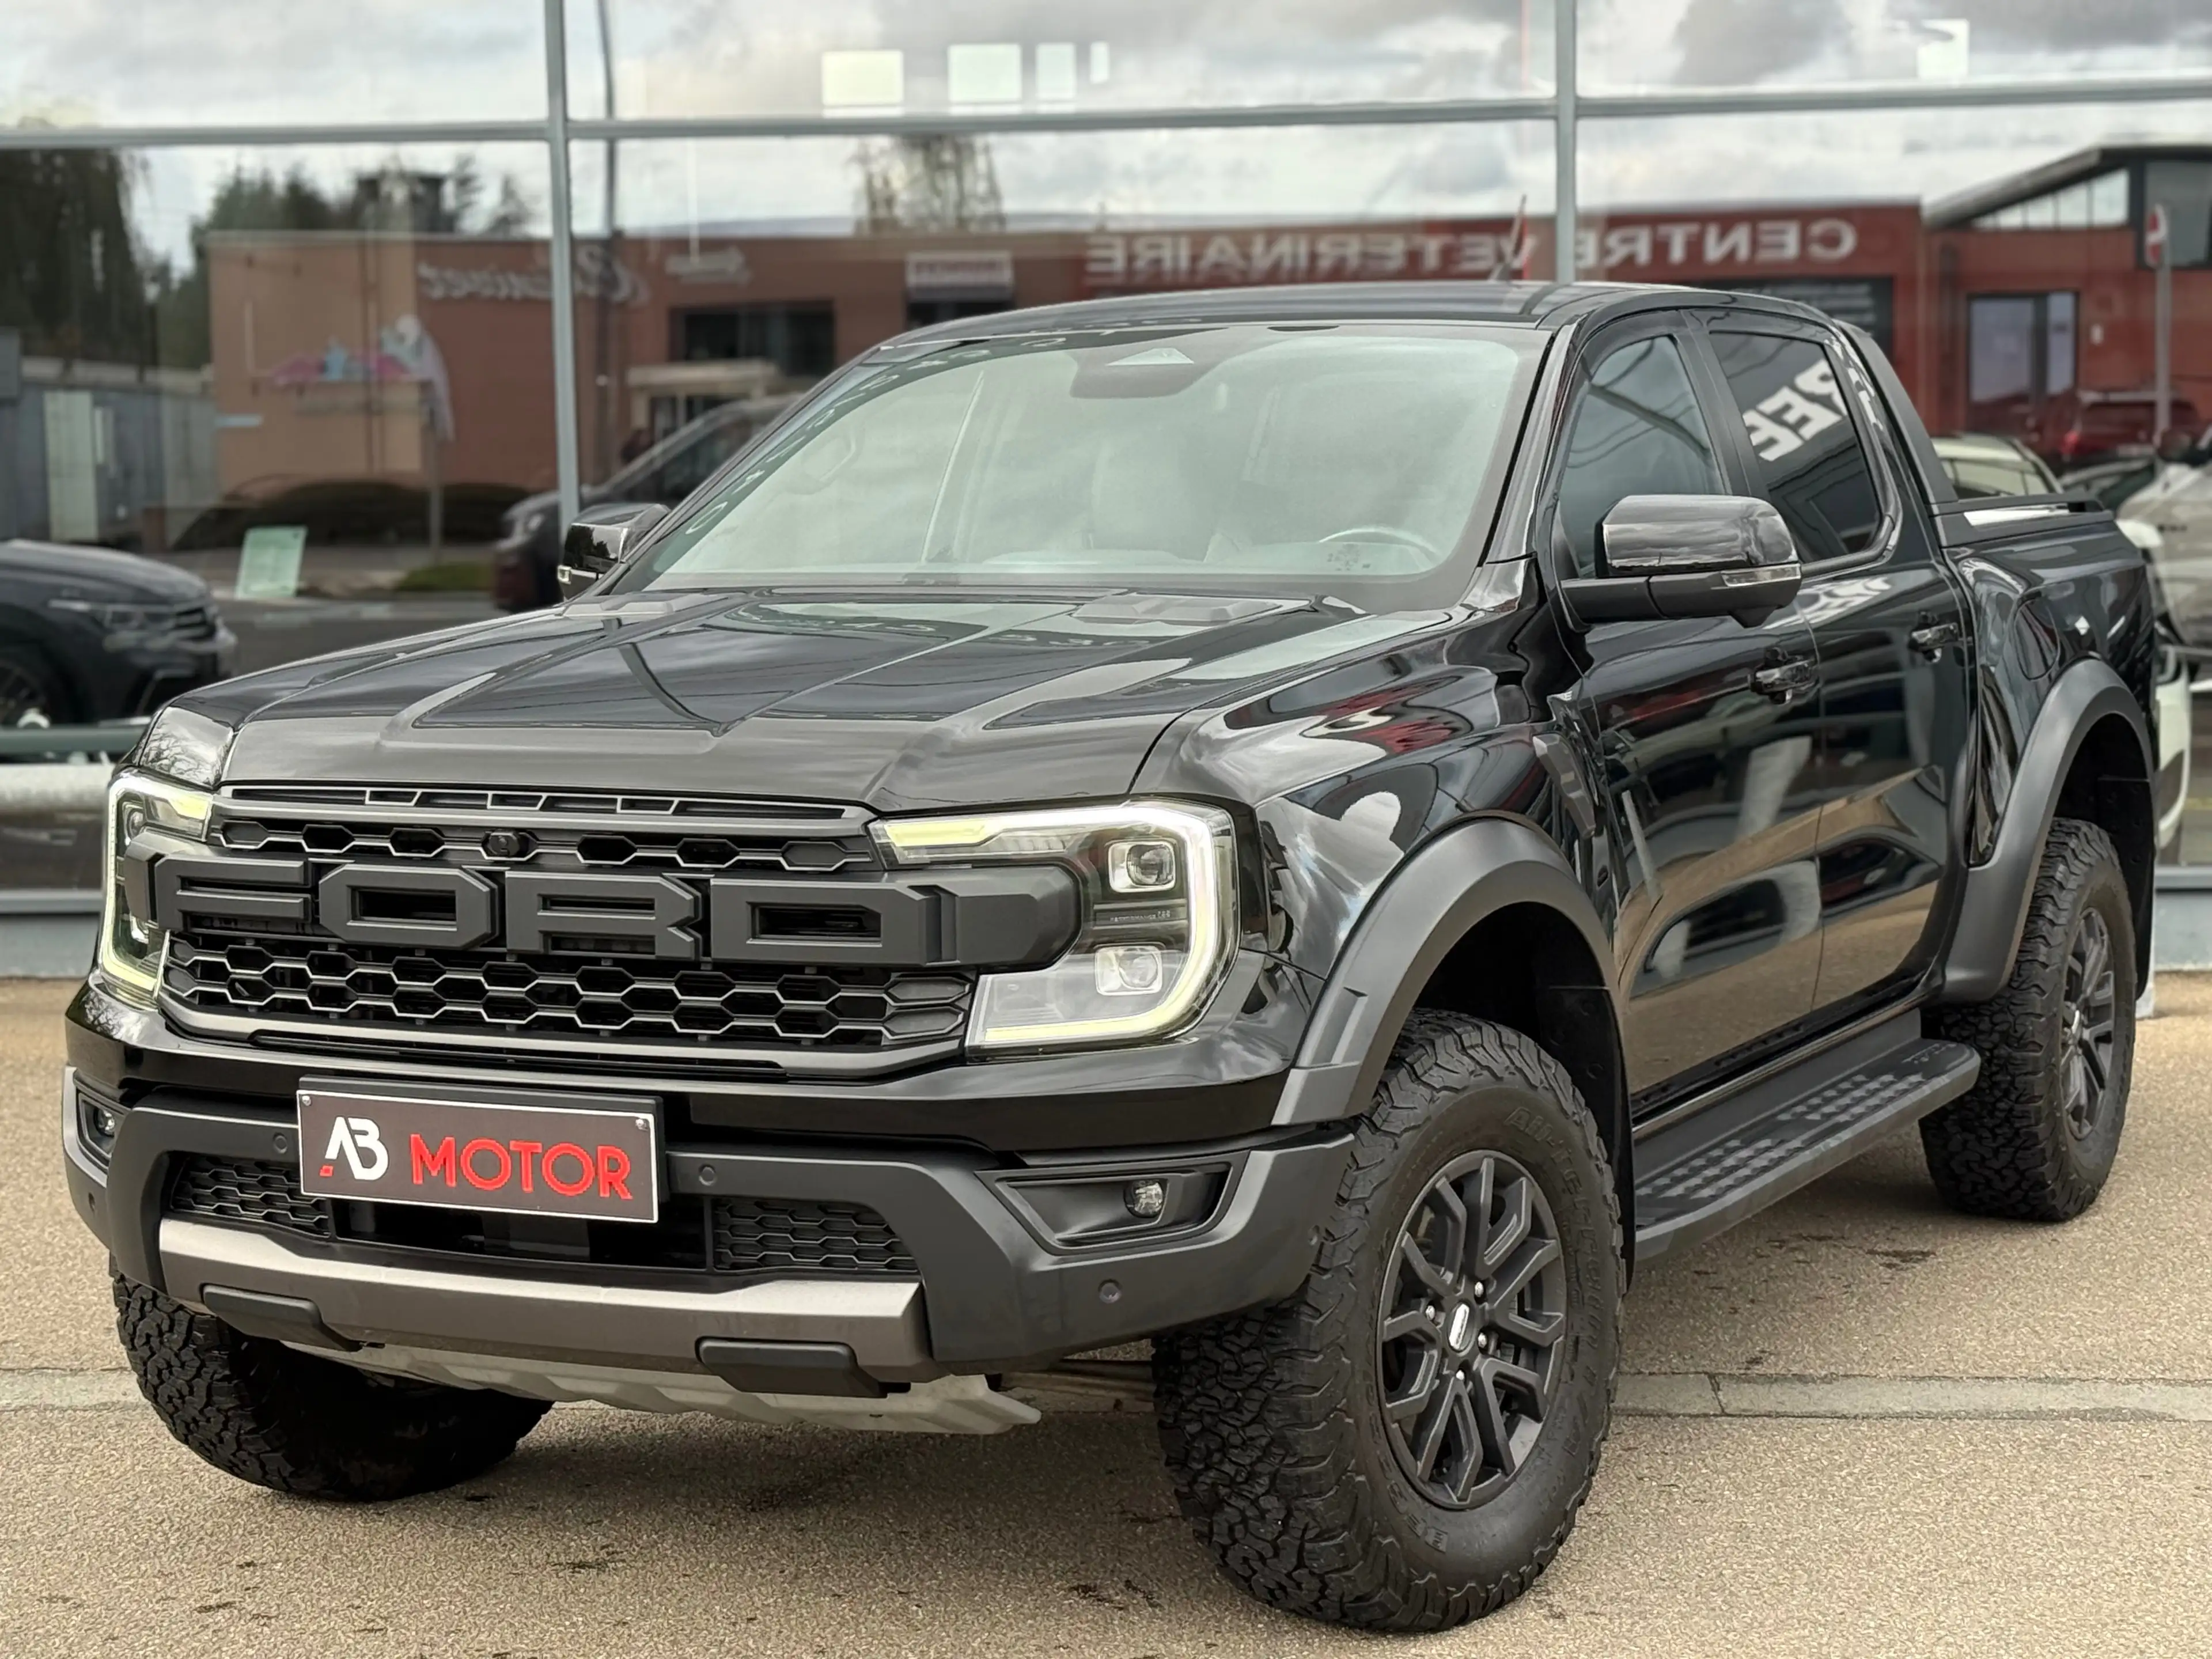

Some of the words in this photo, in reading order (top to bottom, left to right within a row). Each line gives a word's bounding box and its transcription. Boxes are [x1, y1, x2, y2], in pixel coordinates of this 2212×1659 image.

[154, 855, 936, 965] FORD
[320, 1116, 389, 1181] AB
[410, 1134, 633, 1200] MOTOR
